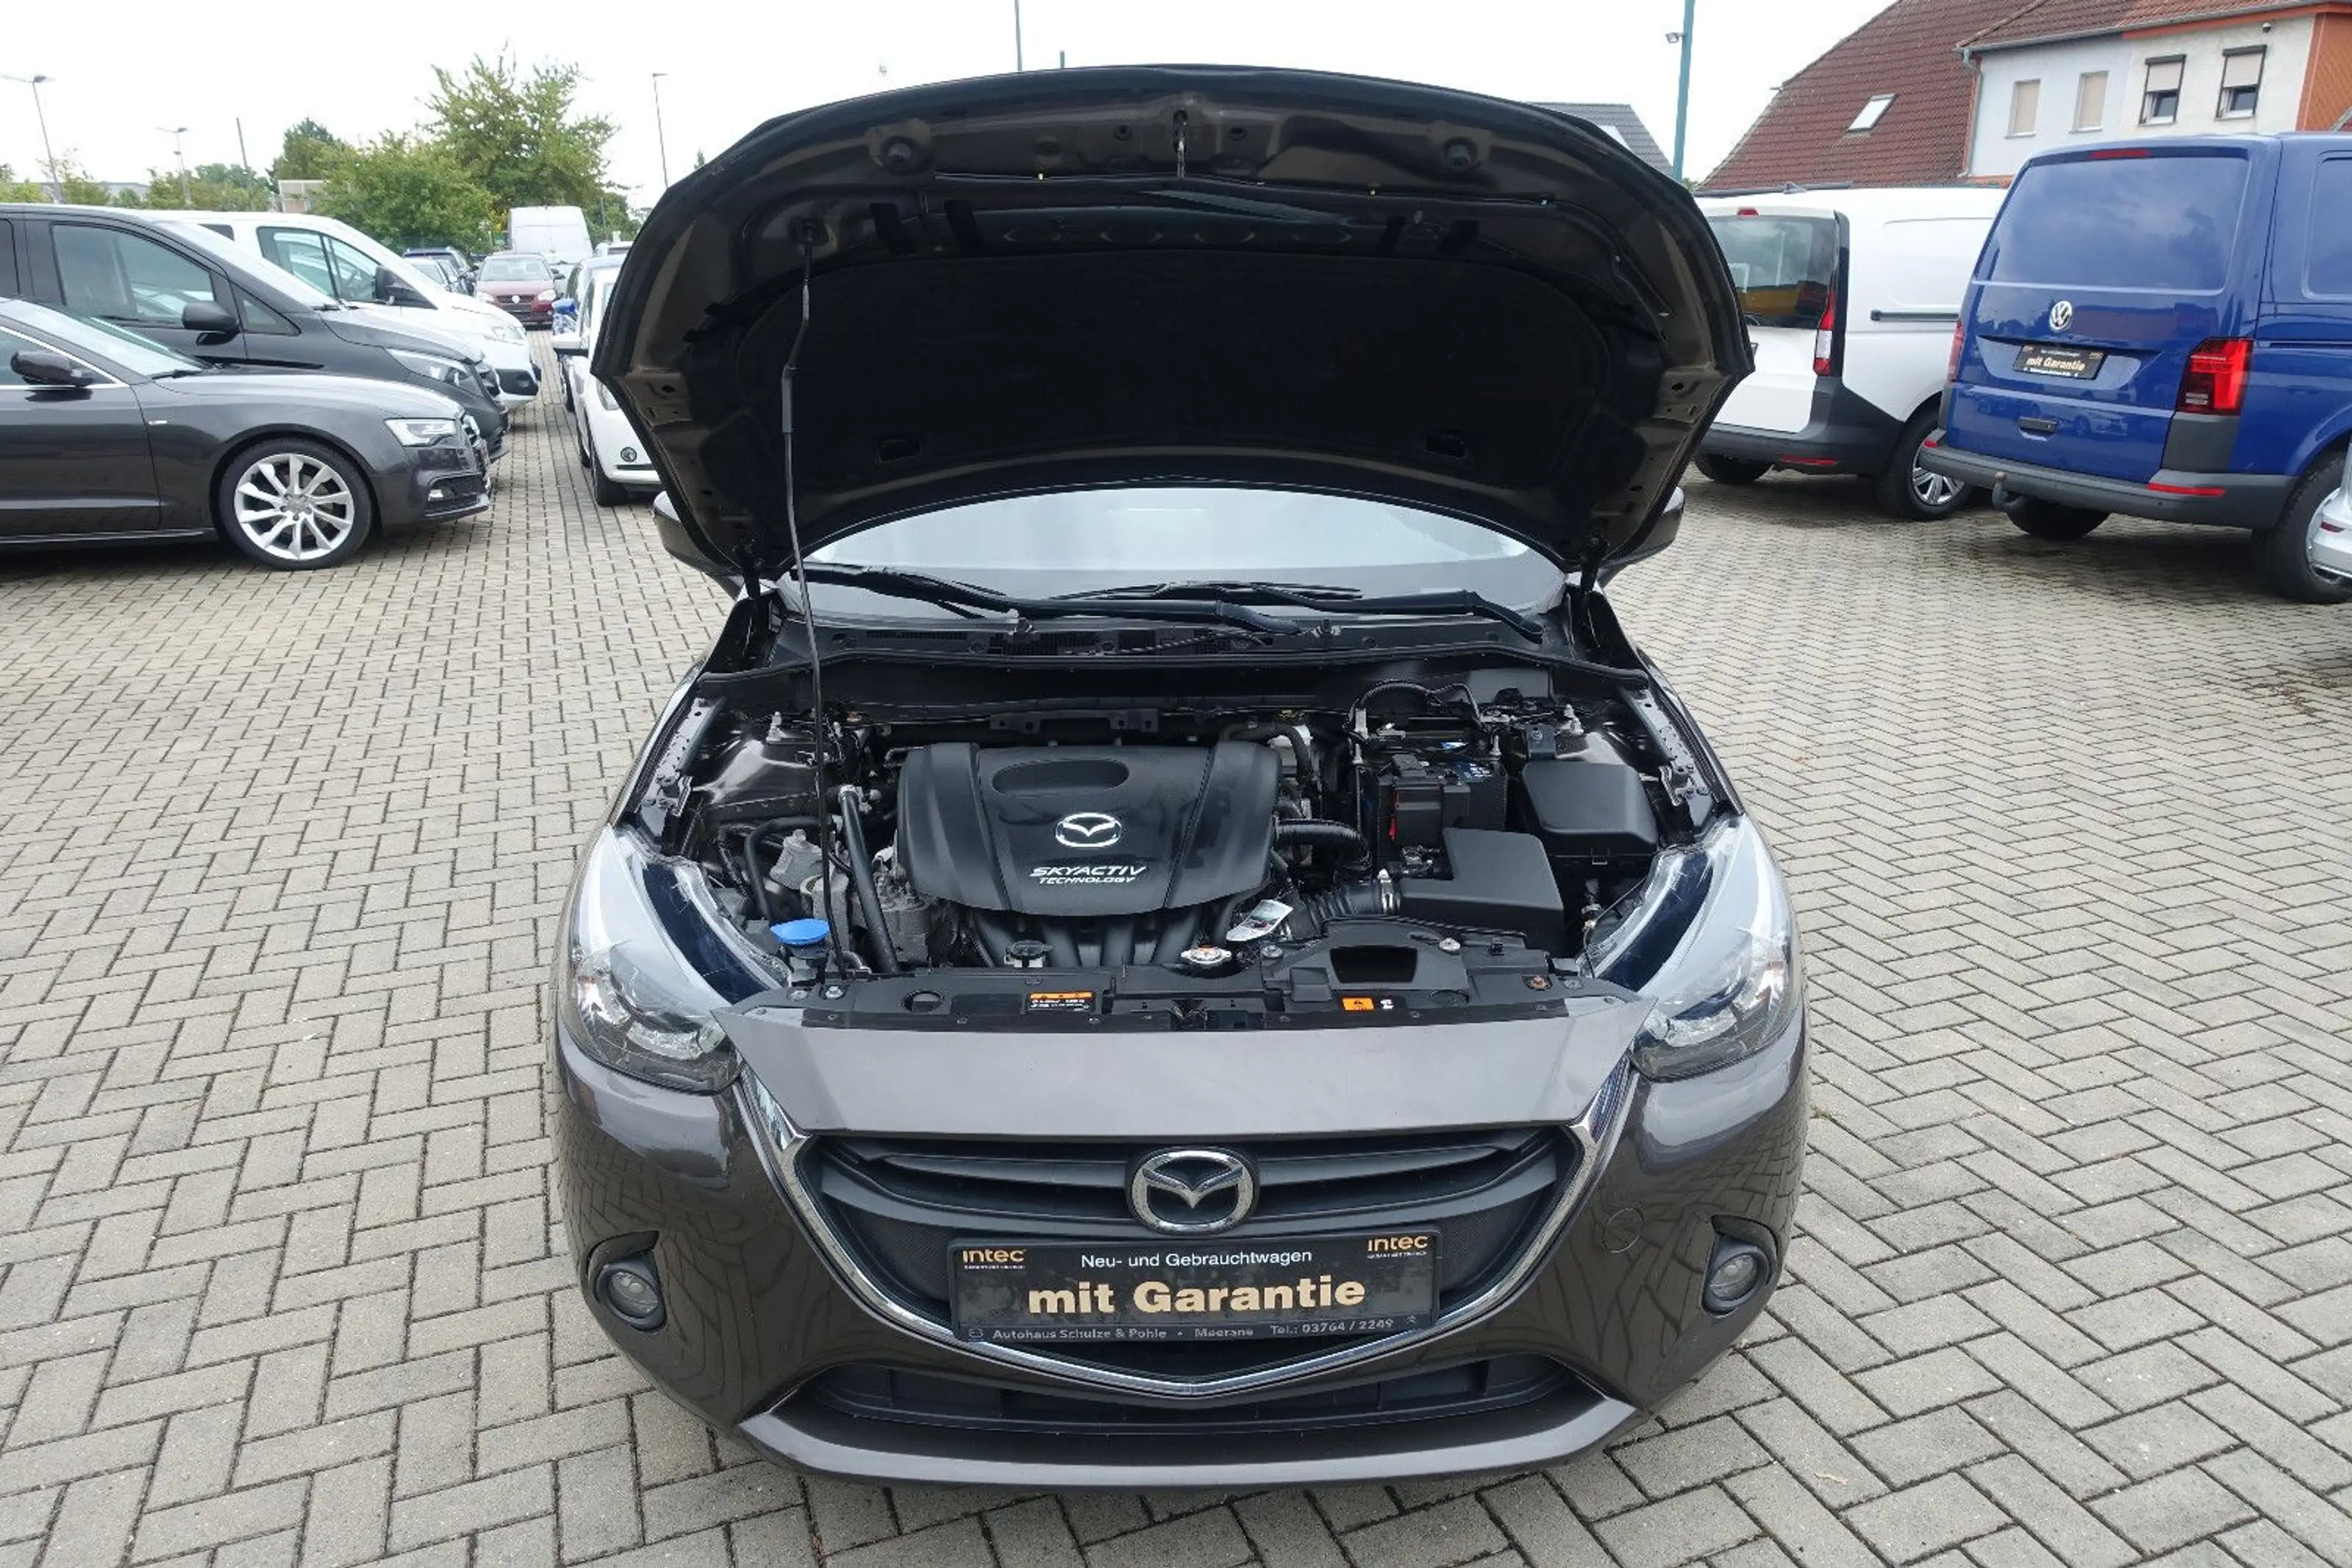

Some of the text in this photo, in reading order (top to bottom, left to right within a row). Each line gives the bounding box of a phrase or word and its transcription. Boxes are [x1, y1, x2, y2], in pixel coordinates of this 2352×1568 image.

[2043, 356, 2086, 371] Garantie
[1029, 865, 1147, 876] SKYACTIV
[1367, 1235, 1429, 1251] intec
[963, 1249, 1025, 1262] intec
[1082, 1250, 1312, 1268] Neu- und Gebrauchtwagen
[1029, 1274, 1365, 1314] mit Garantie
[992, 1329, 1057, 1340] Autohaus
[1060, 1328, 1111, 1339] Schulze
[1115, 1328, 1125, 1338] &
[1302, 1319, 1346, 1333] 03764
[1349, 1321, 1356, 1331] /
